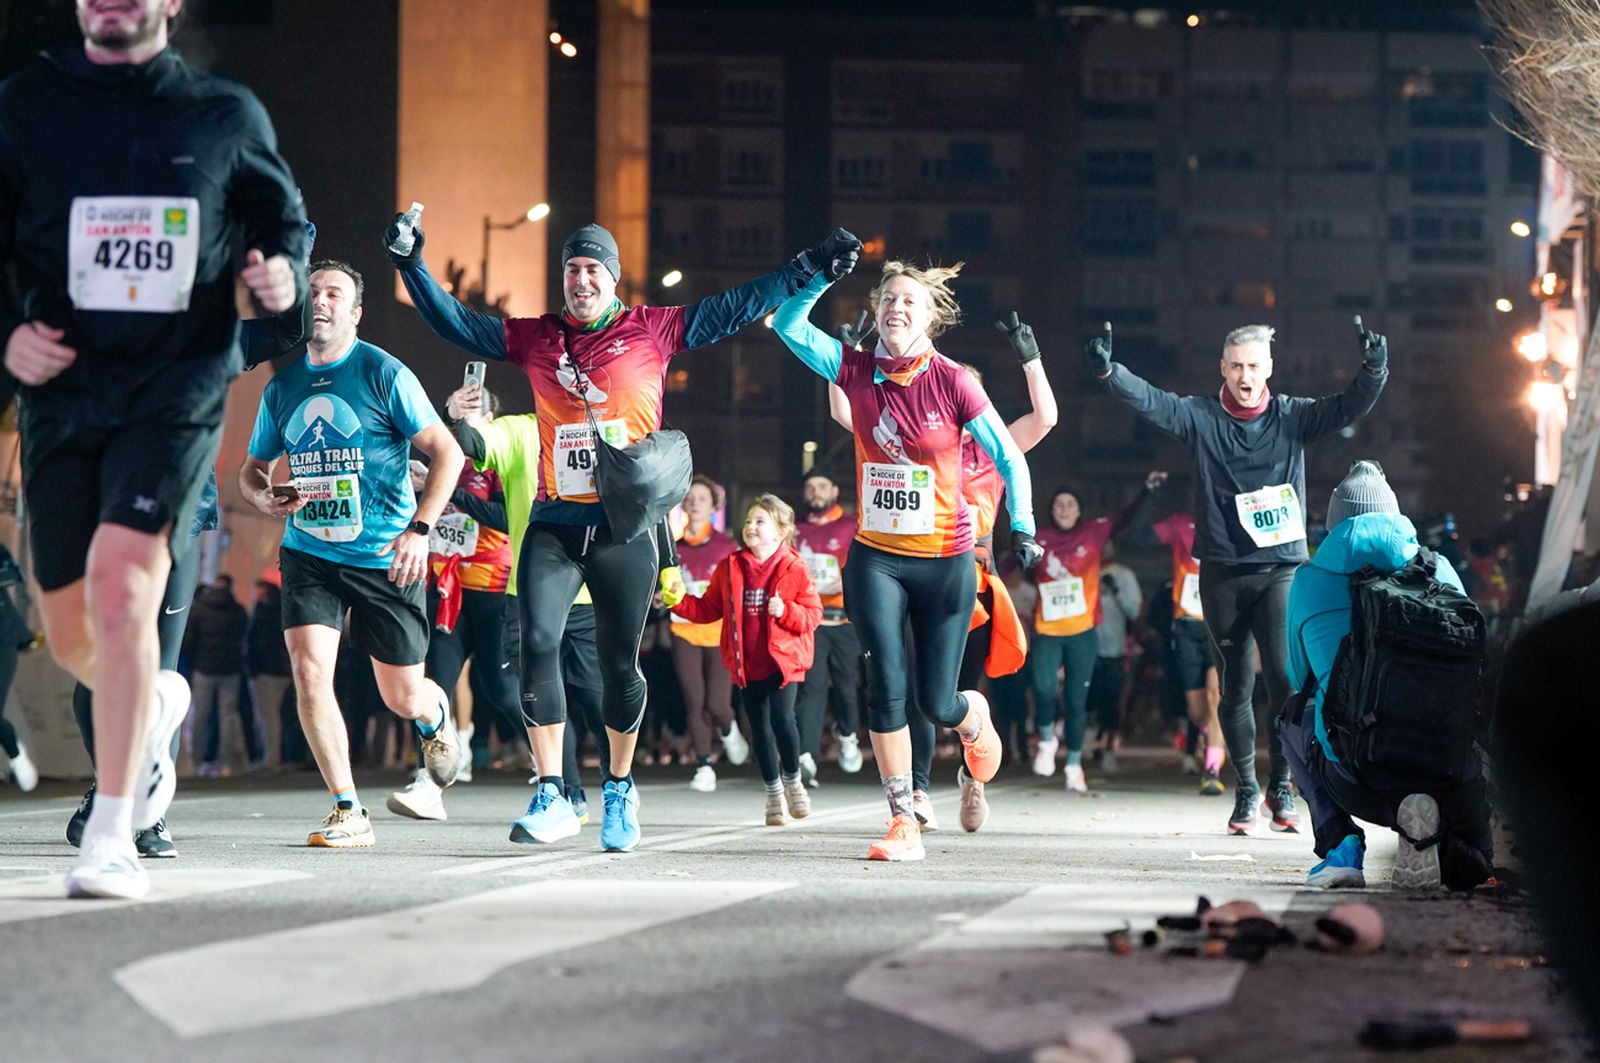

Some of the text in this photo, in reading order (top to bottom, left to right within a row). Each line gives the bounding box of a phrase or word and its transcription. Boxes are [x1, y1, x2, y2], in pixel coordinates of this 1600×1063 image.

[95, 239, 173, 271] 4269
[565, 430, 588, 439] NOCHE
[559, 437, 596, 449] SAN ANTÓ
[883, 438, 902, 459] 43
[324, 447, 365, 463] TRAIL
[290, 461, 365, 476] OSQUES DEL SUR
[876, 471, 895, 480] NOCHE
[302, 484, 321, 492] NOCHE
[322, 483, 331, 491] DE
[869, 479, 906, 489] SAN ANTÓN
[309, 490, 333, 500] ANTÓN
[873, 489, 920, 510] 4969
[302, 499, 351, 521] 13424
